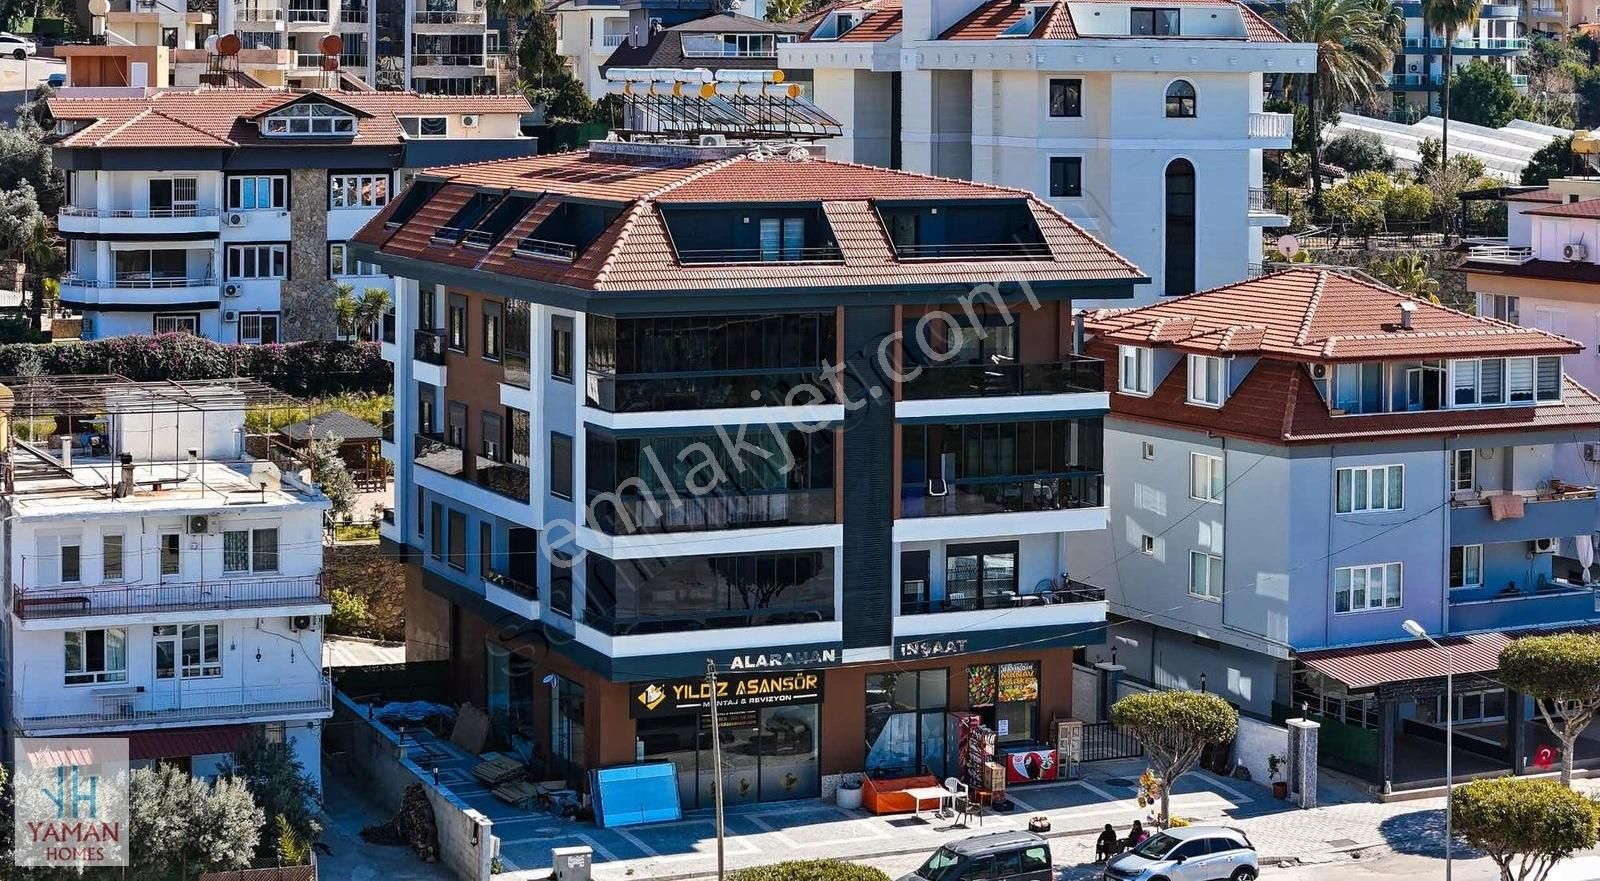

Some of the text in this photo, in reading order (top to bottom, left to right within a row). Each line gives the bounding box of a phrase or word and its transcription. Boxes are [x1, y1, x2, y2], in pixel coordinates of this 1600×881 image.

[730, 649, 836, 670] ALARAHAN
[672, 672, 818, 700] YILDZ ASANSÖR
[702, 699, 739, 708] MNTAJ
